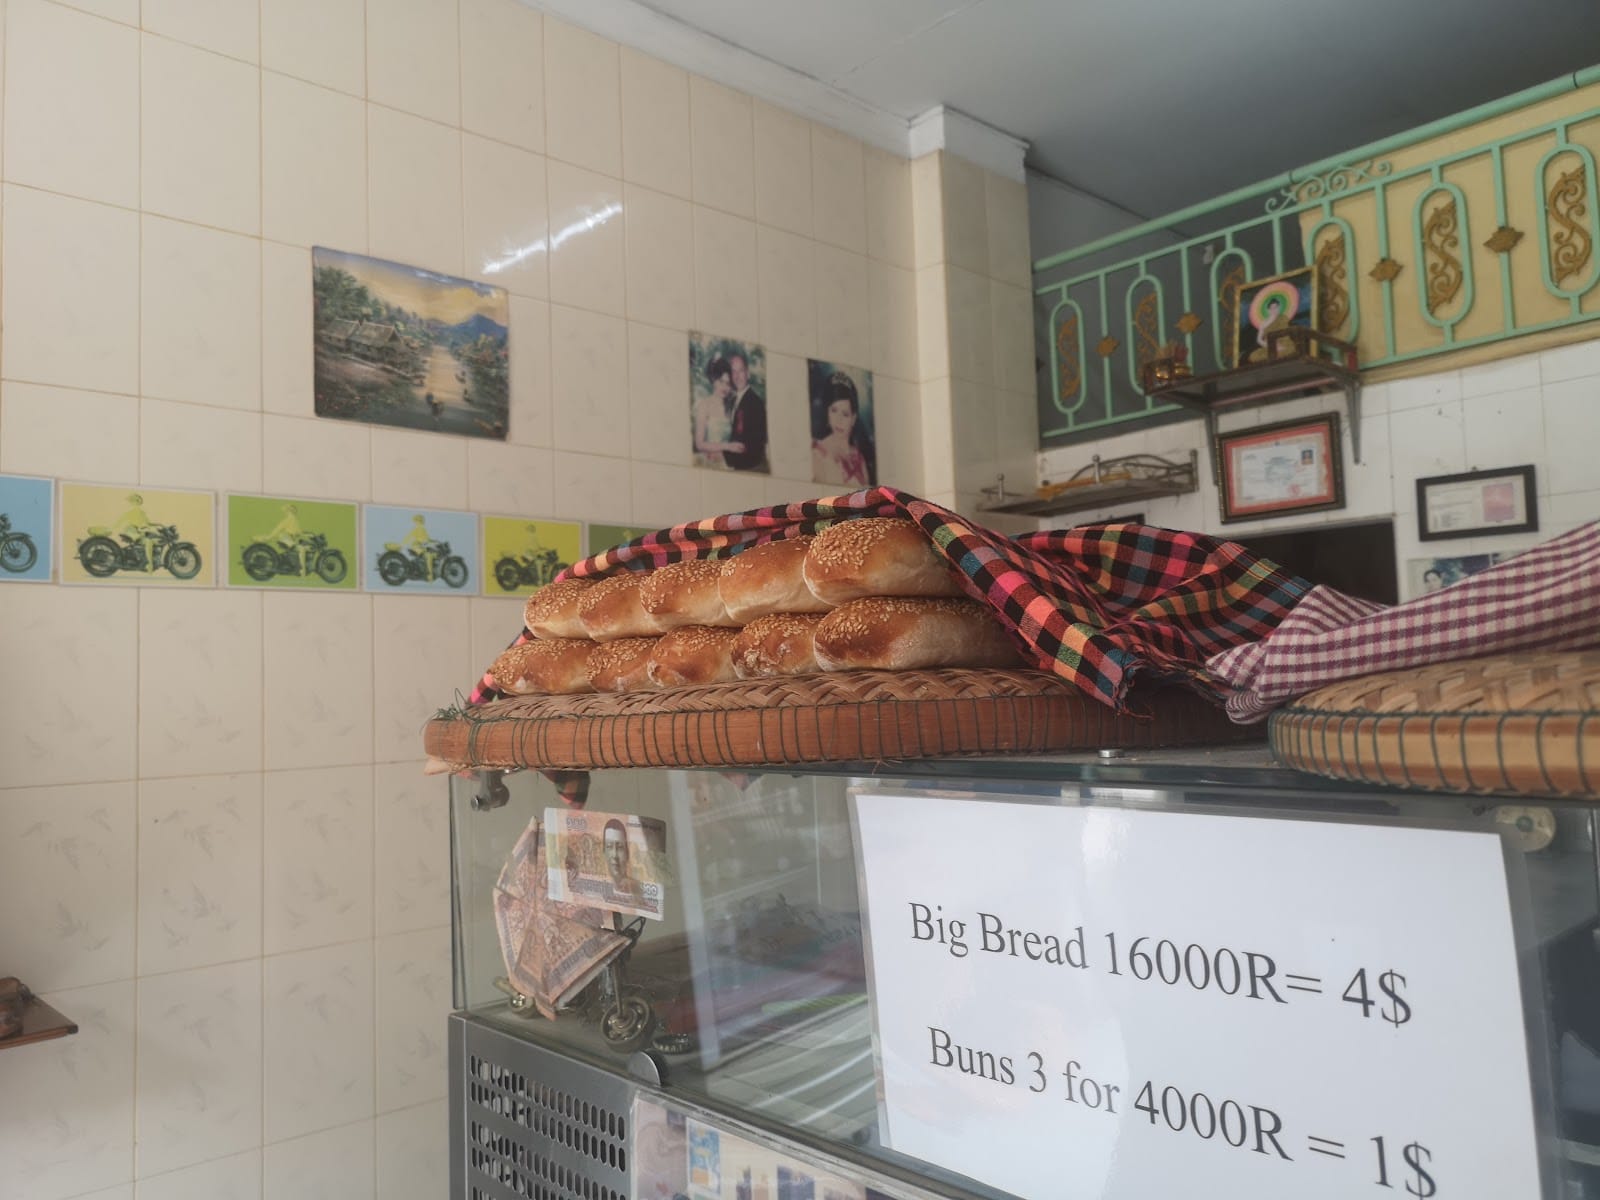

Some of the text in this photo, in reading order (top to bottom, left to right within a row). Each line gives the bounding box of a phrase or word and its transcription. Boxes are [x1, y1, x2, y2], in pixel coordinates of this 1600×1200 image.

[908, 902, 969, 959] Big
[977, 911, 1091, 970] Bread
[1342, 967, 1412, 1029] 4$
[928, 1026, 1438, 1200] Buns 3 for 4000R = 1$
